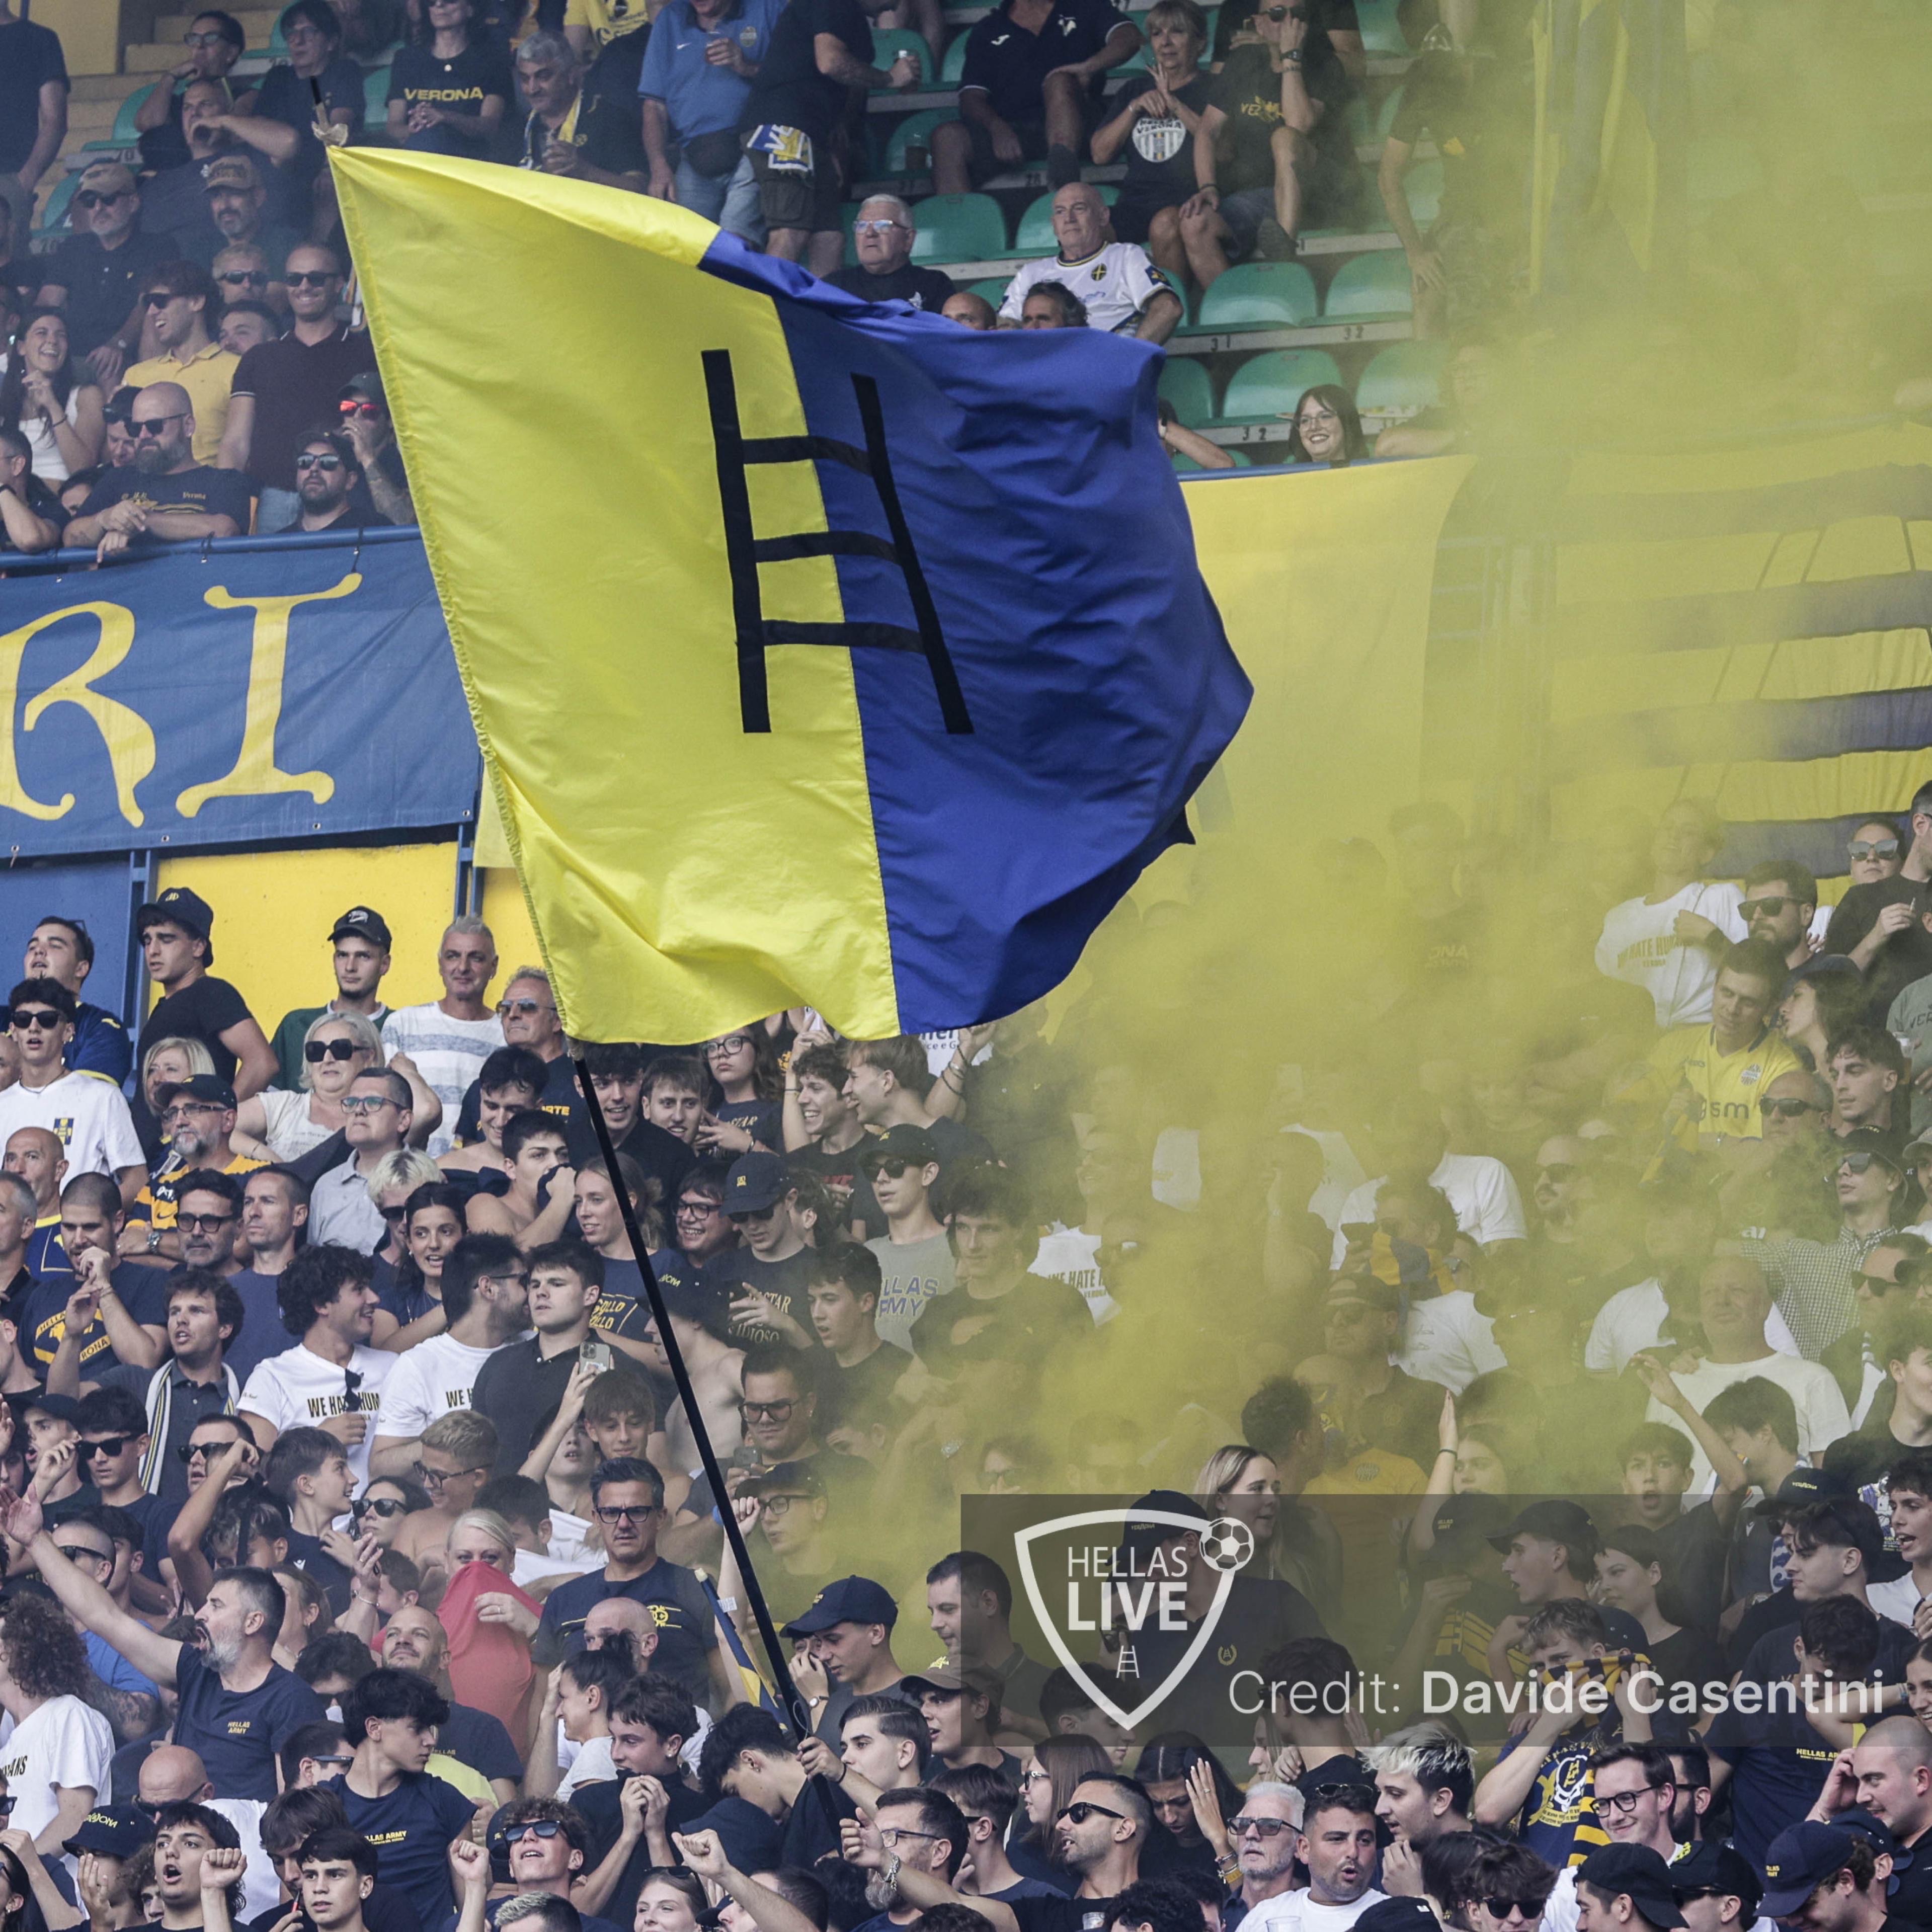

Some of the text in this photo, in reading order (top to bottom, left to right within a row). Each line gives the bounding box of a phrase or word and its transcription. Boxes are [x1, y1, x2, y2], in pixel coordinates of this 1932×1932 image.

[404, 88, 484, 101] VERONA
[1241, 426, 1267, 441] 32
[40, 1312, 66, 1332] HELLA
[81, 1338, 109, 1360] RONA
[307, 1397, 328, 1418] WE
[446, 1390, 465, 1409] WE
[1796, 1748, 1826, 1758] HELLAS
[385, 1830, 407, 1840] ARMY
